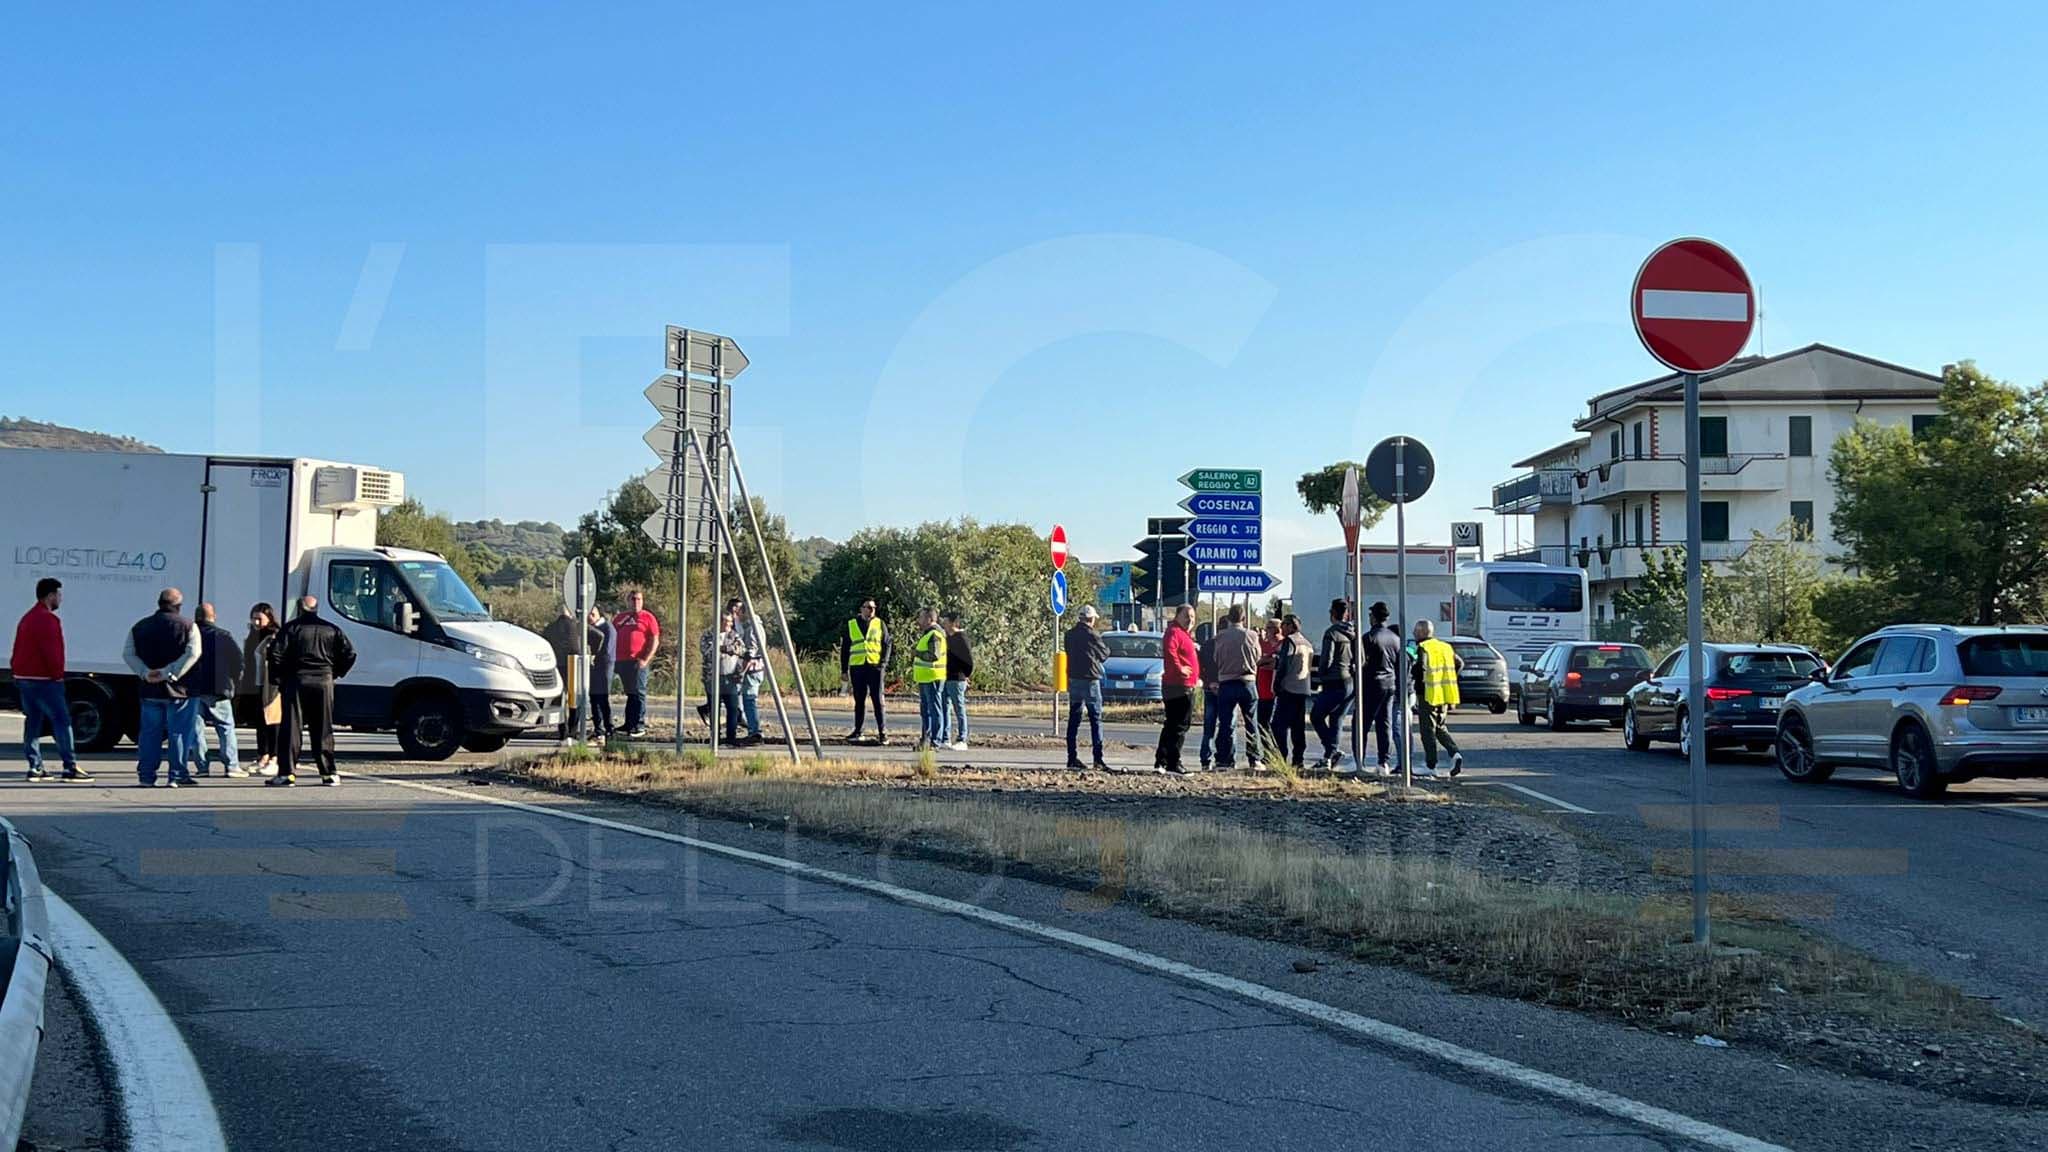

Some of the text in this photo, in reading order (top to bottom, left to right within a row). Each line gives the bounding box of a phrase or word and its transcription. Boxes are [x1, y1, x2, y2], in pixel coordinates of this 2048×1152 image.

[1198, 472, 1239, 480] SALERNO
[1198, 481, 1231, 489] REGGIO
[1198, 499, 1255, 511] COSENZA
[1196, 524, 1228, 534] REGGIO
[1245, 525, 1258, 534] 372
[1195, 548, 1258, 560] TARANTO 108
[1203, 575, 1263, 588] AMENDOLARA
